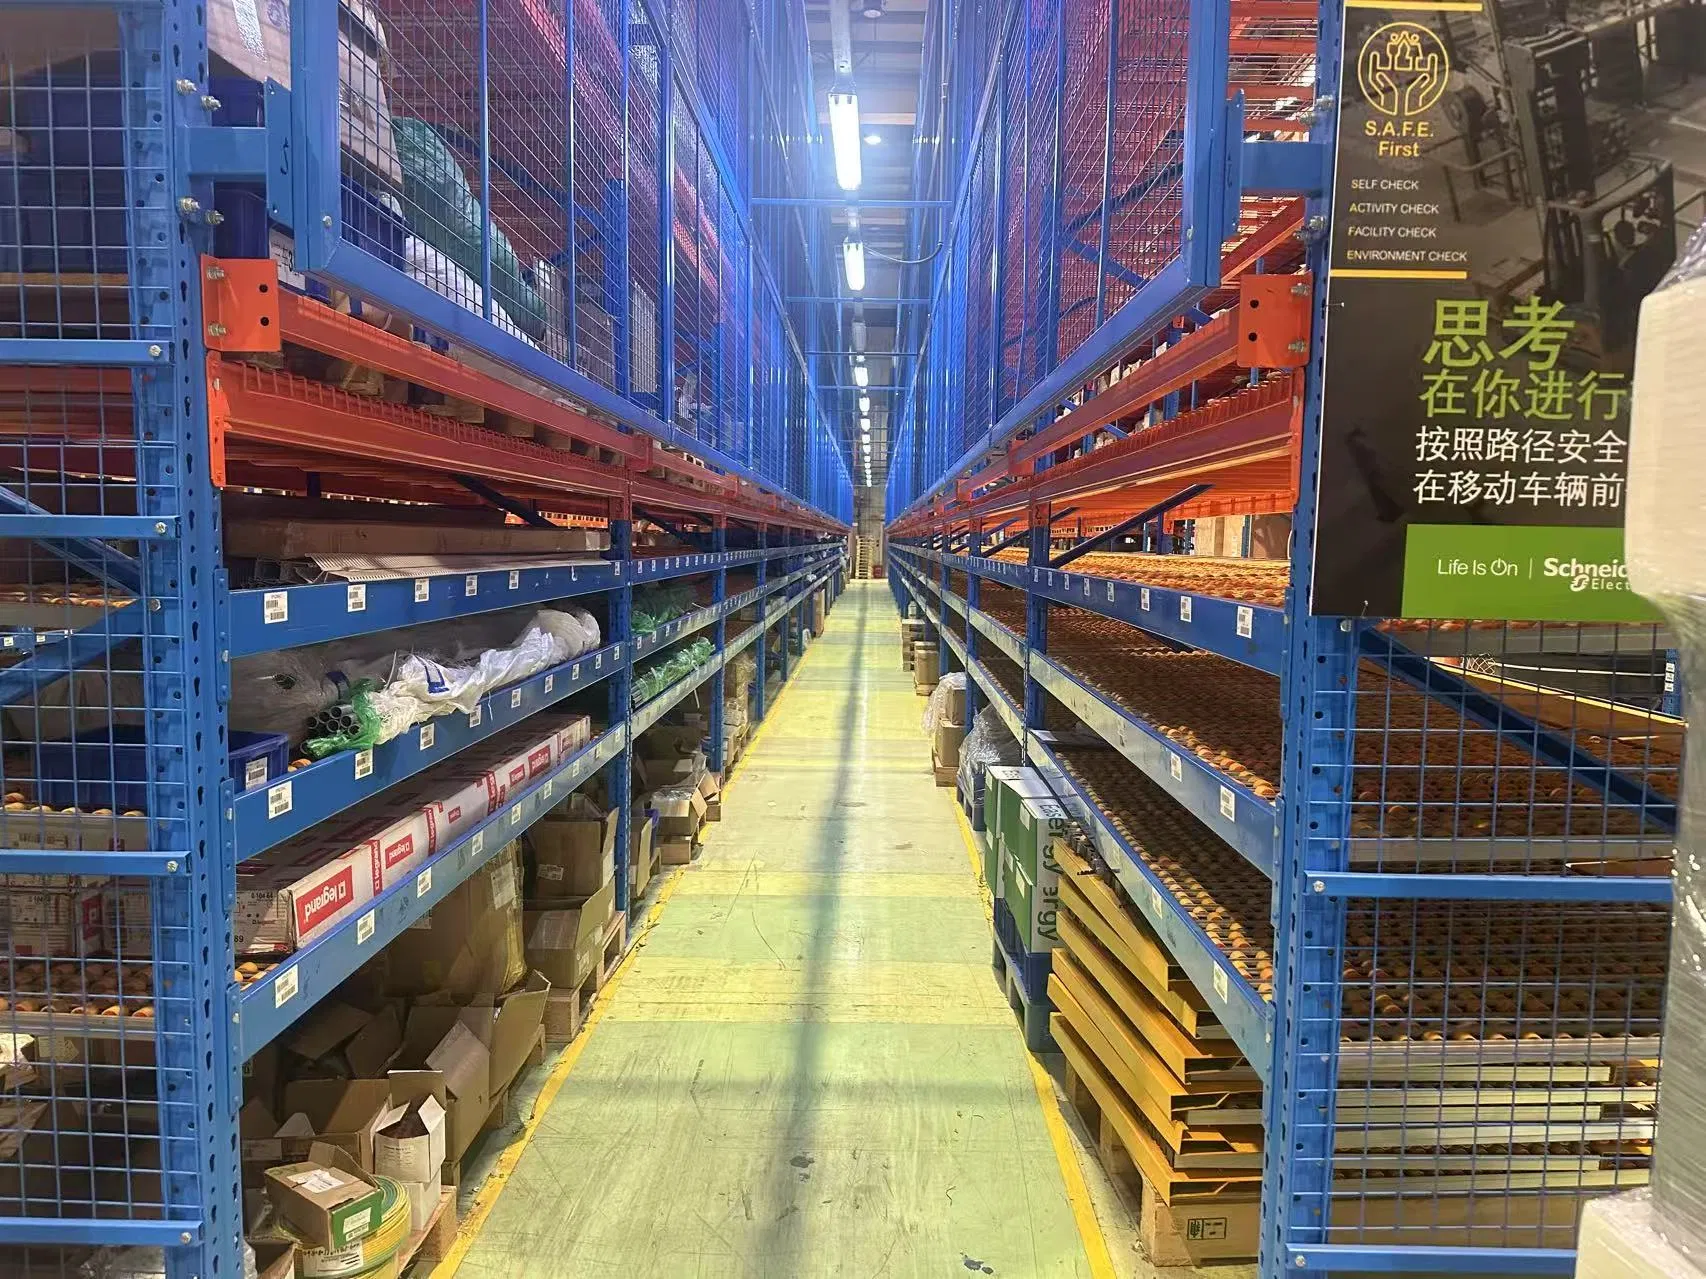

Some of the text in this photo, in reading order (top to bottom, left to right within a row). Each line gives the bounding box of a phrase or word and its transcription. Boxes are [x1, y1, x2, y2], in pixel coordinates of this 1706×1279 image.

[1364, 120, 1434, 137] S.A.F.E.
[1378, 141, 1420, 157] First
[1351, 179, 1419, 191] SELF CHECK
[1349, 202, 1440, 214] ACTIVITY CHECK
[1348, 226, 1437, 238] FACILITY CHECK
[1347, 250, 1468, 262] ENVIRONMENT CHECK
[1422, 295, 1576, 370] 思考
[1415, 425, 1628, 463] 按照路径安全
[1412, 468, 1625, 508] 在移动车辆前
[1437, 558, 1518, 576] Life Is On
[303, 883, 338, 923] legrand
